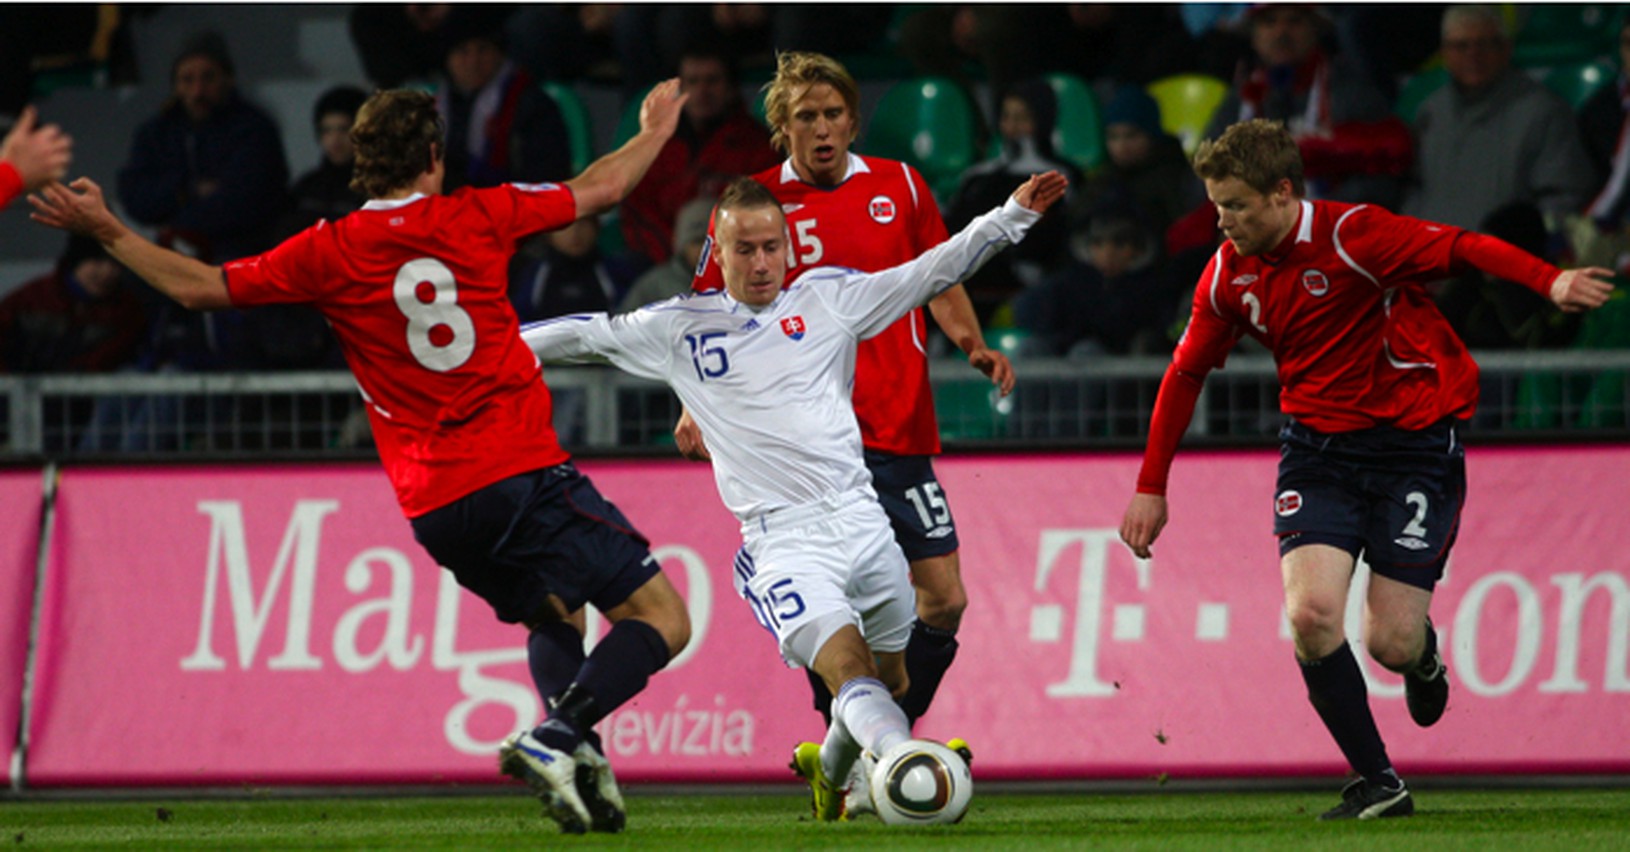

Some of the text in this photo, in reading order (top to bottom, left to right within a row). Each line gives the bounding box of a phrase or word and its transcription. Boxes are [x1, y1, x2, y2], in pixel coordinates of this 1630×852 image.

[784, 218, 825, 270] 15
[393, 257, 475, 372] 8
[1241, 291, 1268, 334] 2
[685, 332, 730, 382] 15
[905, 482, 950, 529] 15
[1405, 491, 1428, 538] 2
[179, 500, 714, 756] Mago
[763, 577, 806, 630] 15
